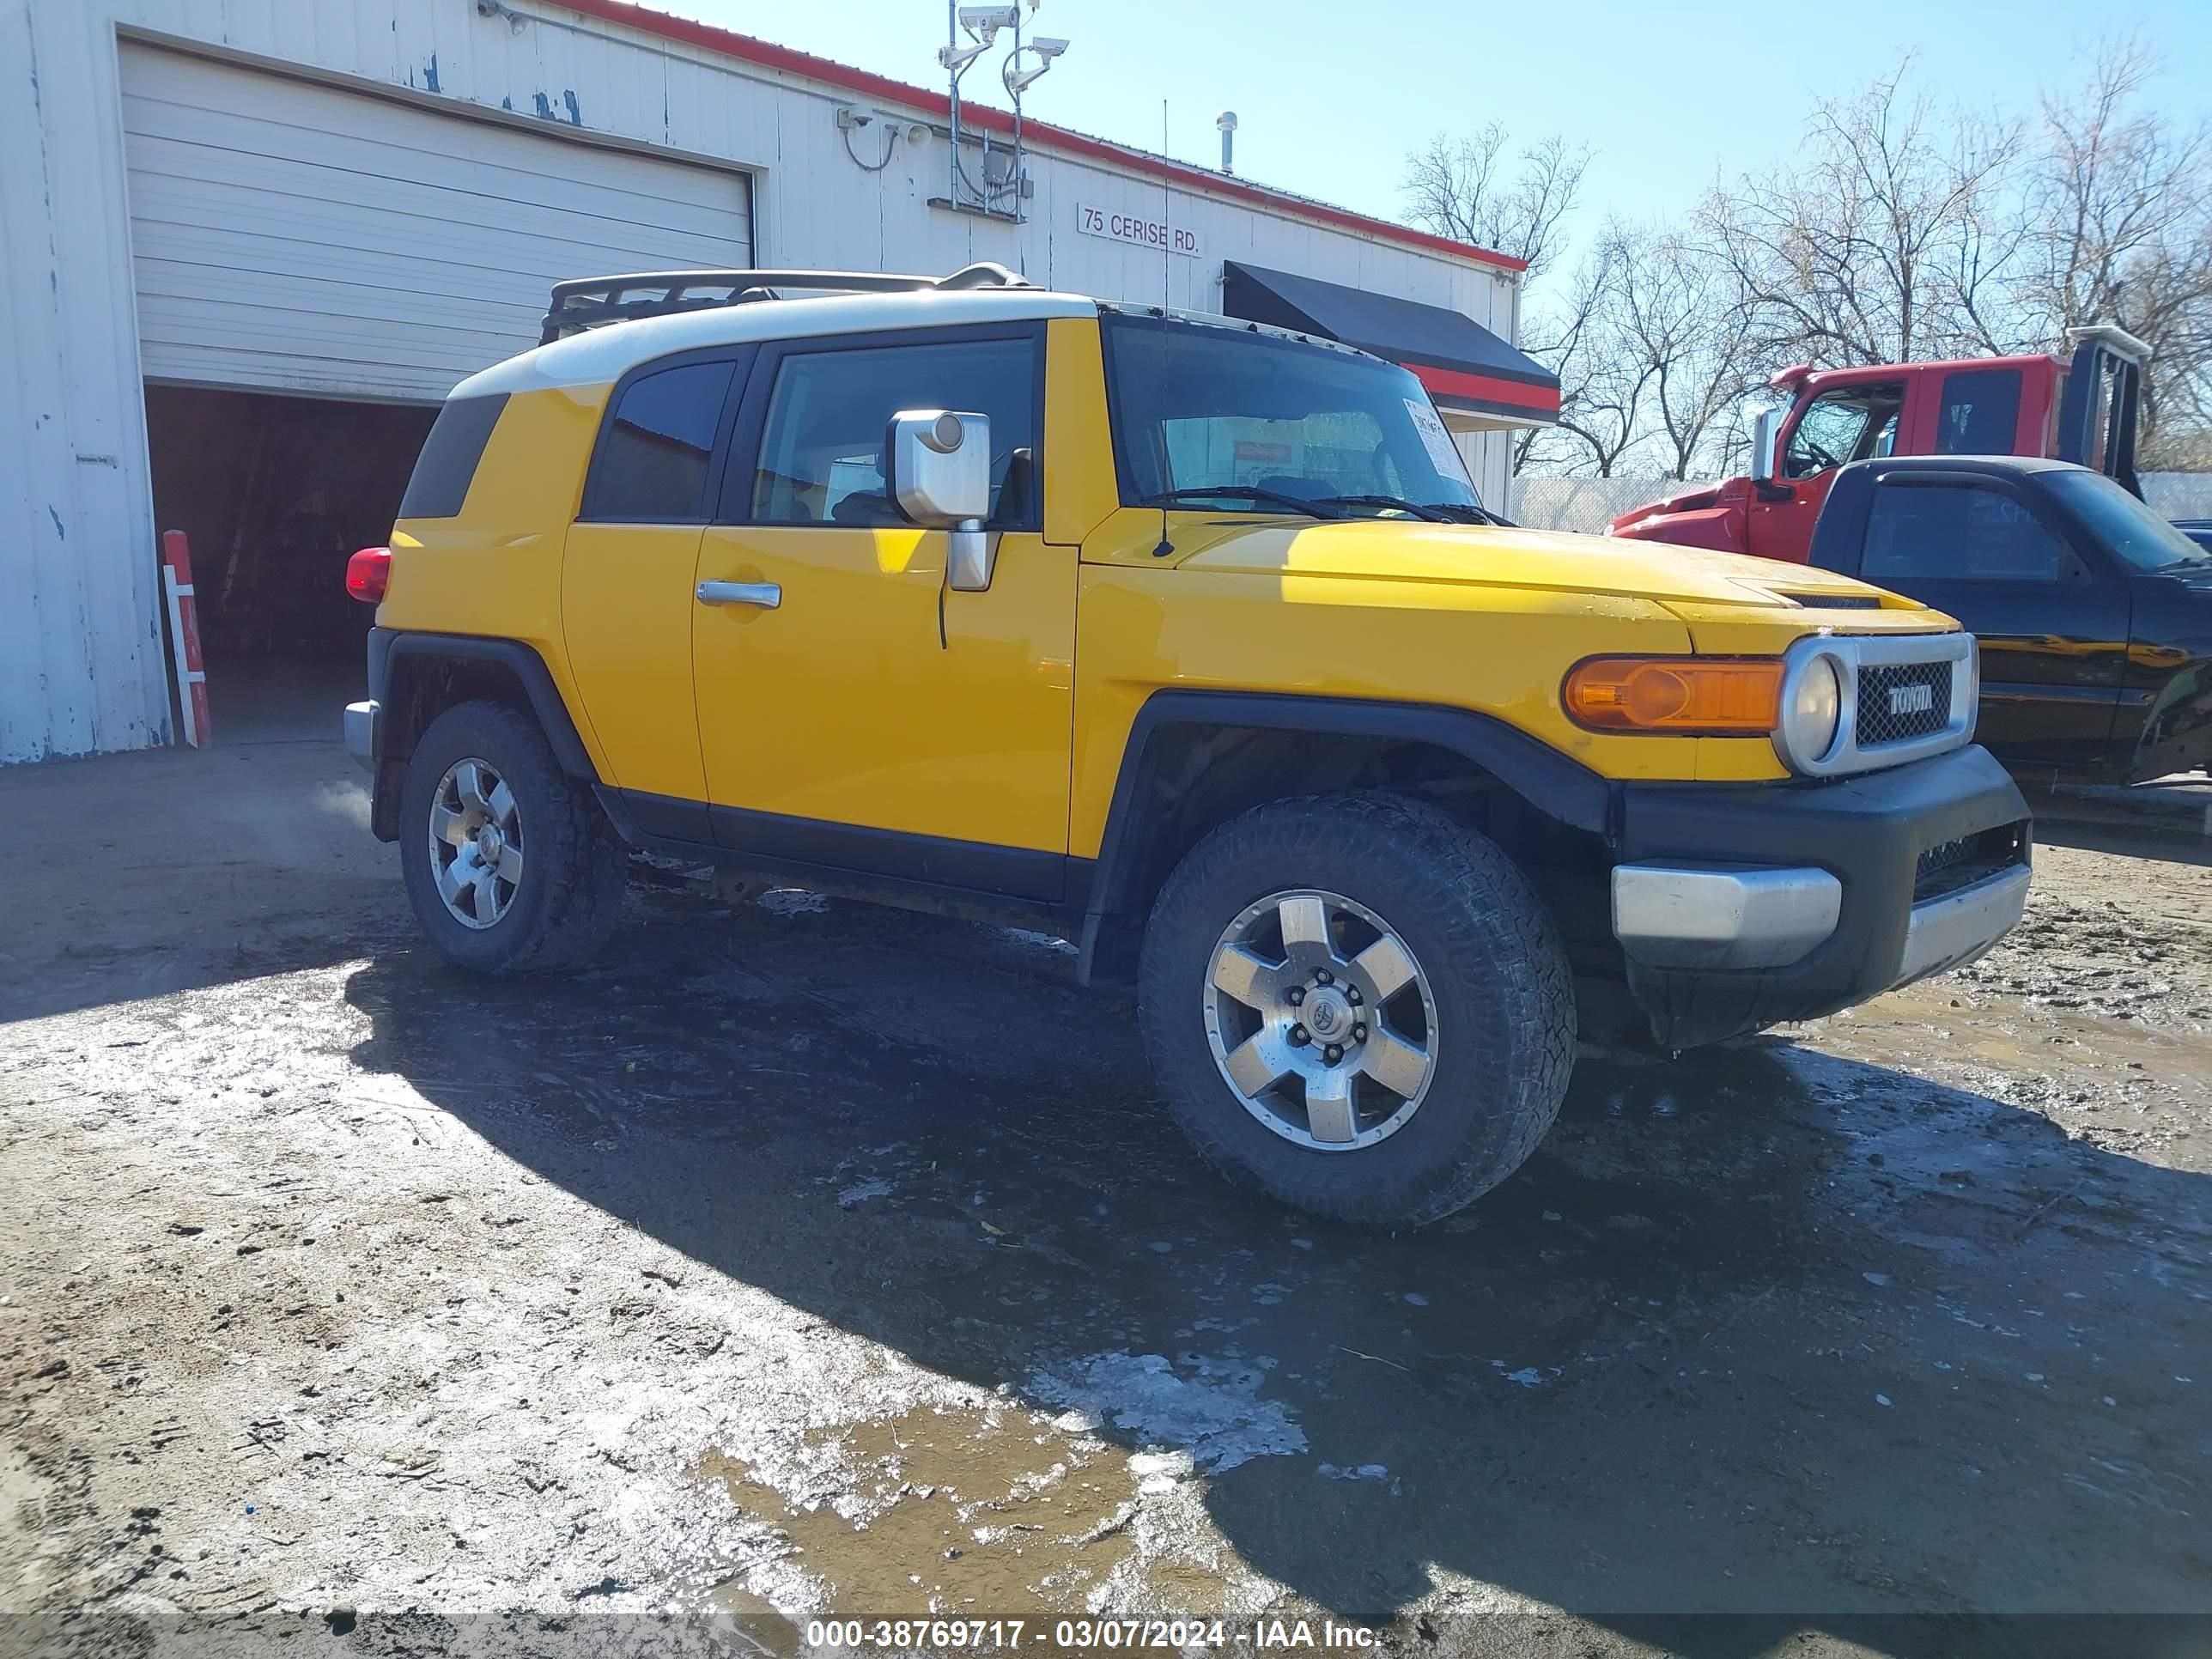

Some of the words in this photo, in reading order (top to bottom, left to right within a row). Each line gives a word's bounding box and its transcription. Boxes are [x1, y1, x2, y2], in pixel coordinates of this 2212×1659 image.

[1084, 208, 1103, 232] 75
[1110, 215, 1168, 246] CERISE
[1175, 229, 1199, 252] RD.
[1889, 684, 1932, 715] TOYOTA
